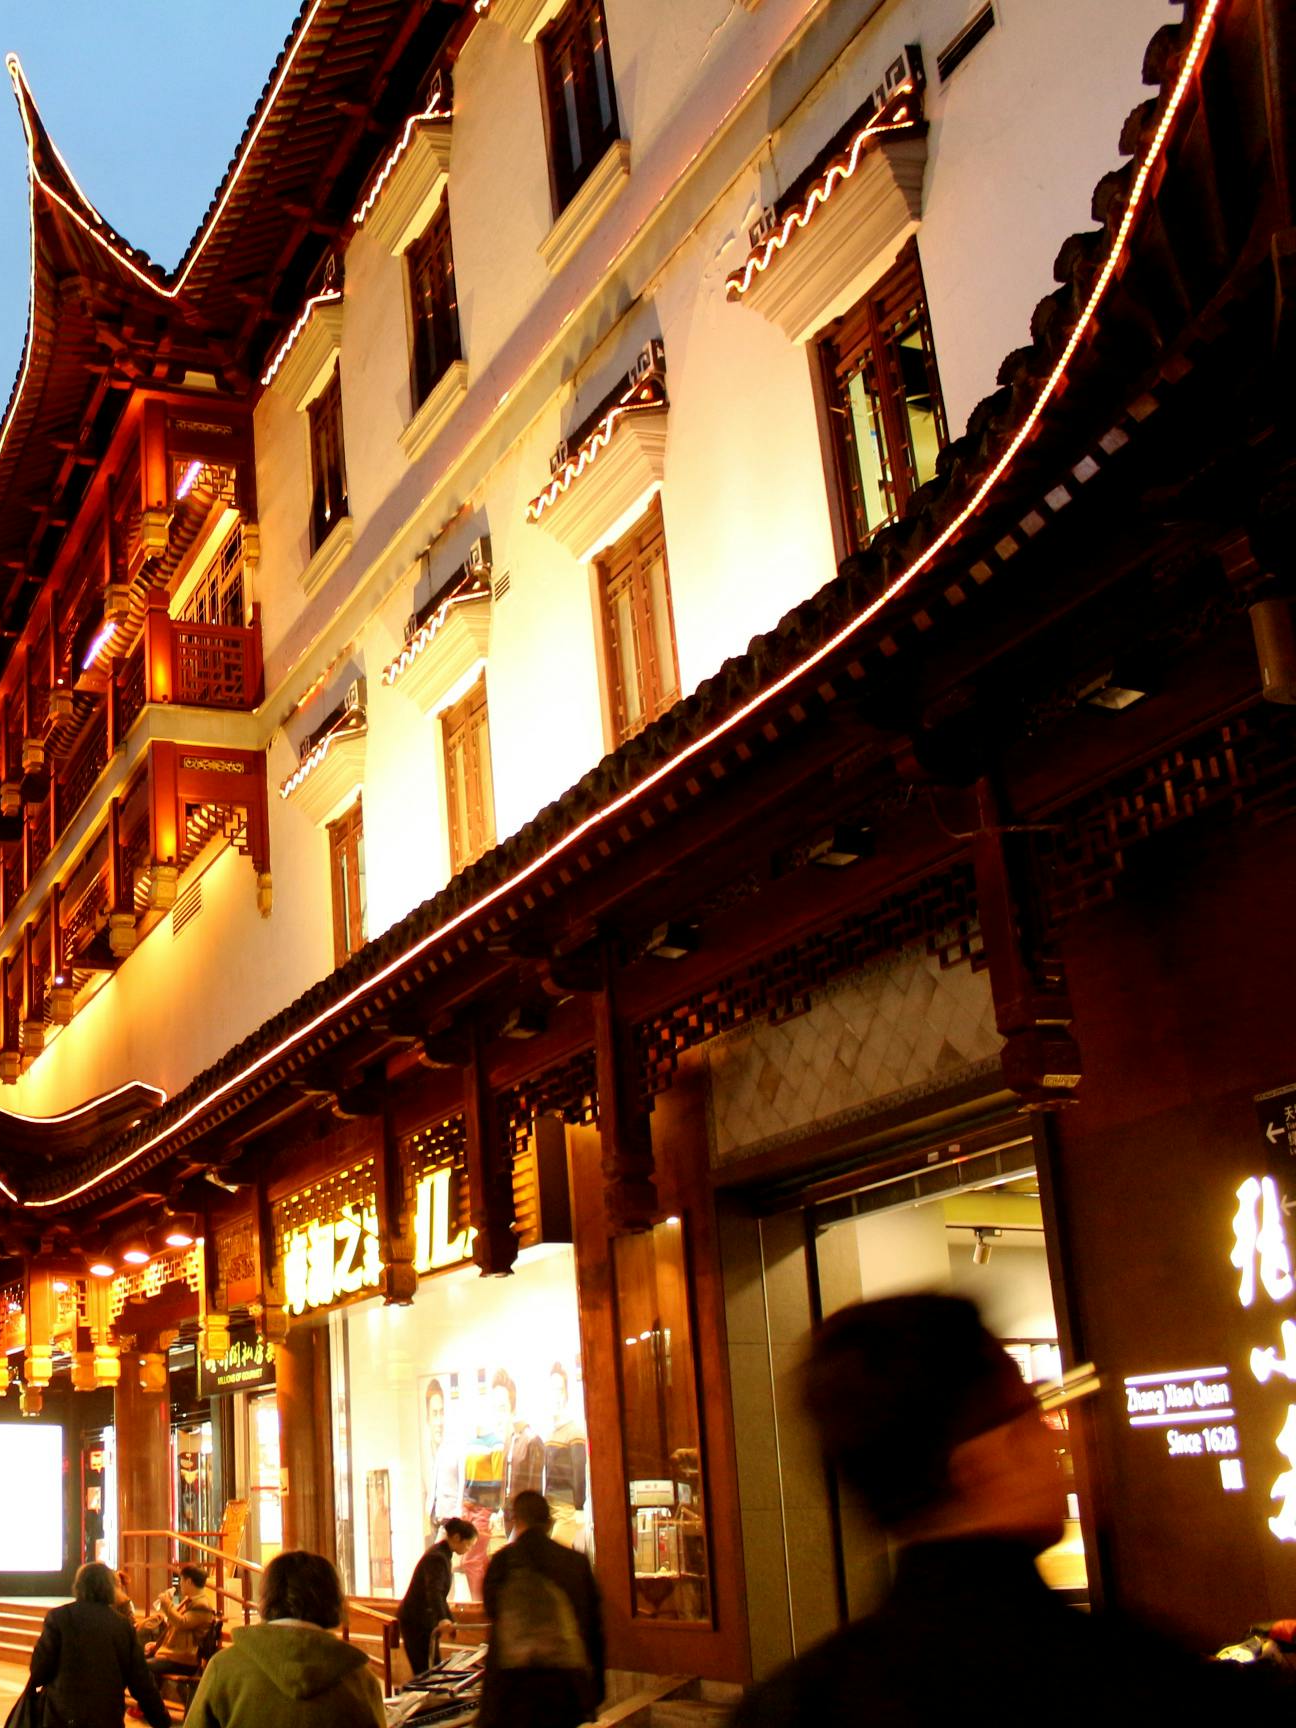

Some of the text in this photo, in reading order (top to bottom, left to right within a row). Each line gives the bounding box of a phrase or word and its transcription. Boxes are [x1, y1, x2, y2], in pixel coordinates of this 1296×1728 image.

[1125, 1380, 1229, 1415] Zhang Xiao Quan
[1166, 1425, 1237, 1455] Since 1628
